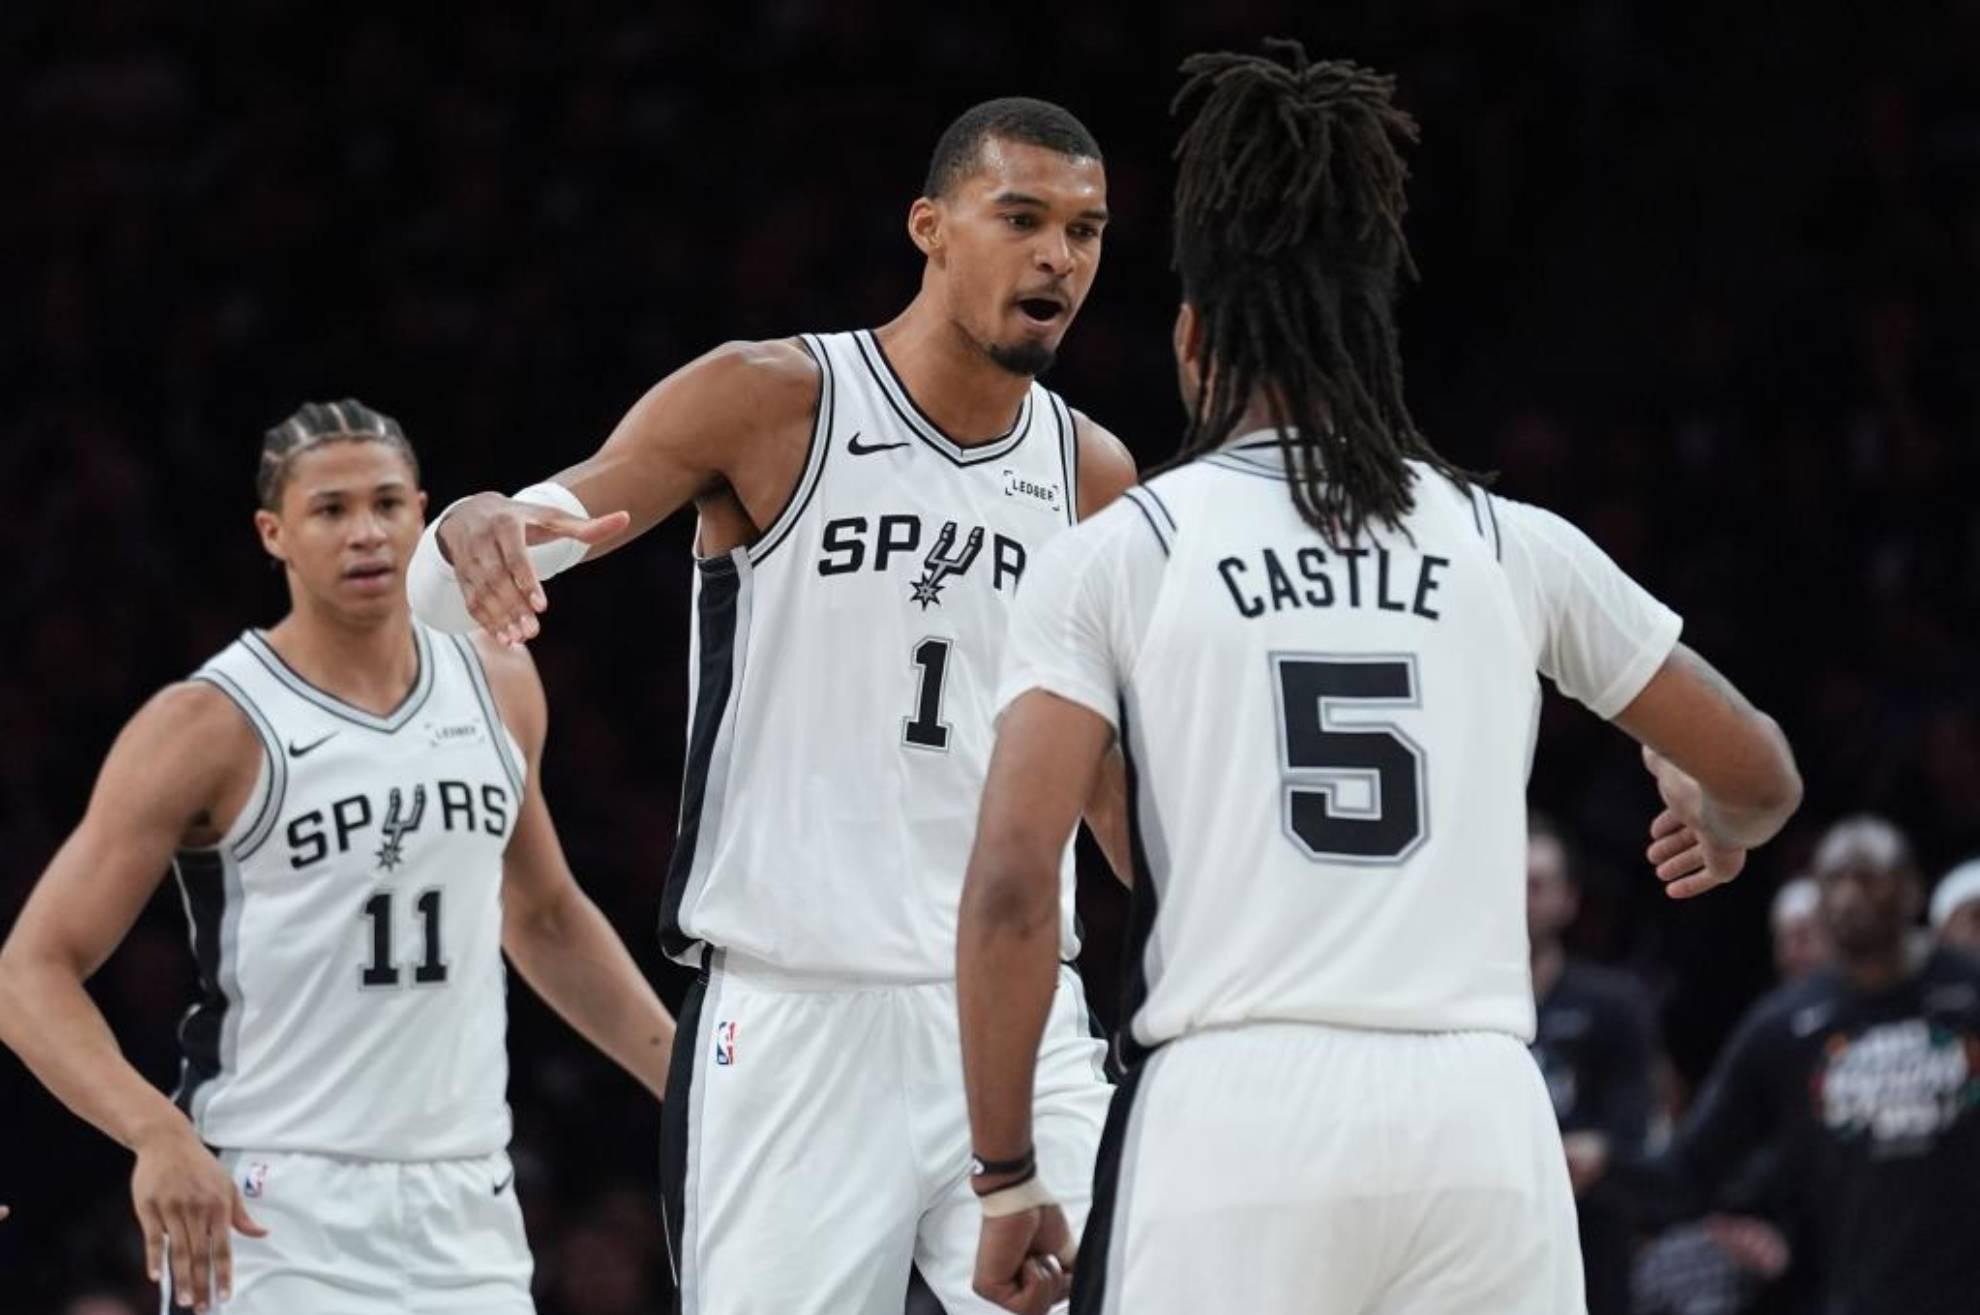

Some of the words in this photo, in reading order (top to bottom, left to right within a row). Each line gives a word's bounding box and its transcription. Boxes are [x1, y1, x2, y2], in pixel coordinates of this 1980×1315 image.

[818, 514, 1027, 612] SPUR
[1217, 548, 1450, 621] CASTLE
[904, 636, 952, 752] 1
[1269, 651, 1430, 866] 5
[286, 780, 507, 872] SPURS
[359, 884, 452, 991] 11
